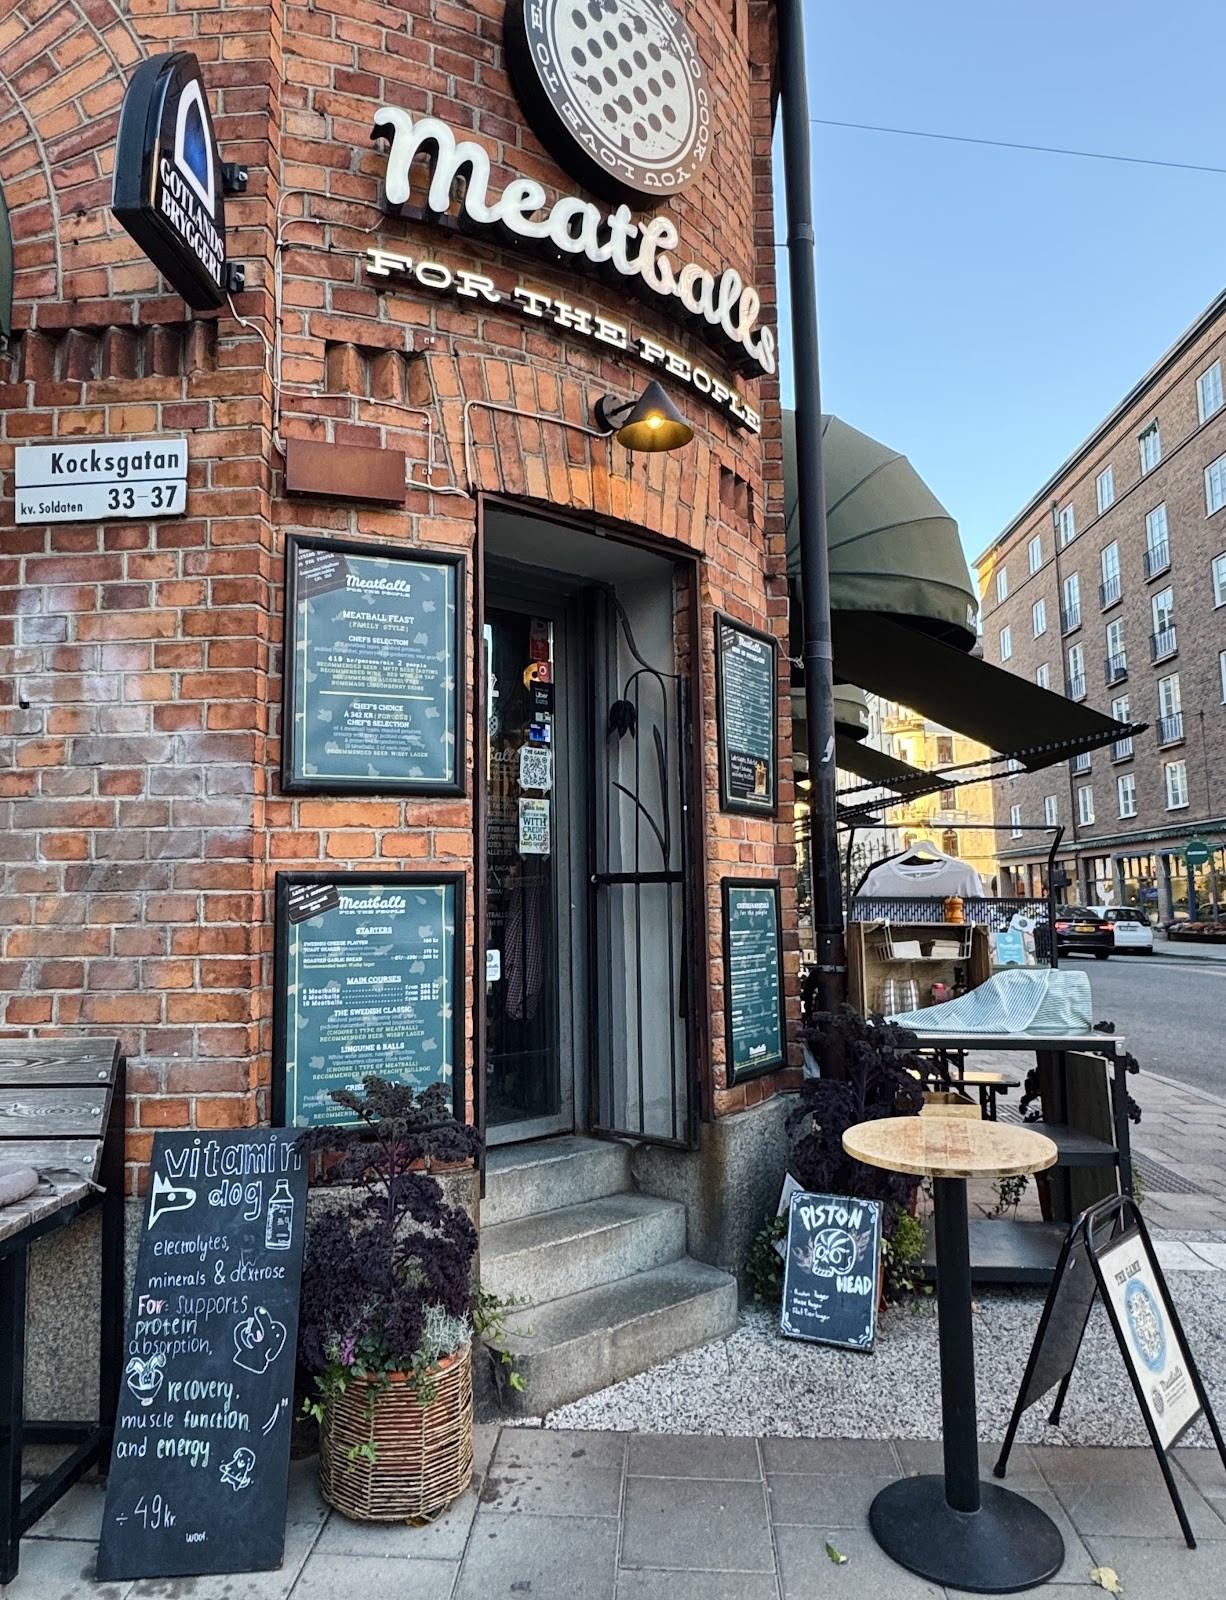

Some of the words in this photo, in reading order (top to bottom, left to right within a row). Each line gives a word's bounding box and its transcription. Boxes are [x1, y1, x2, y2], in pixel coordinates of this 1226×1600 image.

[536, 43, 560, 94] TO
[693, 88, 710, 162] COOK
[562, 102, 635, 180] LOVE
[643, 167, 692, 188] YOU
[160, 158, 224, 262] GOTLANDS
[161, 186, 220, 287] BRYGGERI
[367, 248, 500, 302] FOR
[514, 288, 626, 350] THE
[640, 336, 761, 434] PEOPLE
[52, 449, 178, 478] Kocksgatan
[21, 502, 35, 514] kv.
[39, 500, 83, 513] Soldaten
[346, 574, 411, 592] Meatballs
[342, 611, 386, 622] MEATBALL
[389, 615, 414, 624] FEAST
[373, 637, 409, 646] SELECTION
[523, 817, 546, 826] WITH
[523, 834, 546, 842] CARDS
[339, 896, 406, 909] Meatballs
[356, 927, 392, 935] STARTERS
[347, 977, 367, 985] MAIN
[368, 976, 402, 984] COURSES
[320, 1034, 366, 1042] RECOMMENDED
[341, 1044, 375, 1053] LINGUINE
[382, 1042, 405, 1050] BALLS
[313, 1072, 360, 1080] RECOMMENDED
[165, 1135, 301, 1177] vitamin
[208, 1179, 262, 1222] dog
[800, 1205, 862, 1231] PISTON
[154, 1235, 229, 1261] electrolytes,
[149, 1270, 205, 1288] minerals
[214, 1260, 226, 1285] &
[230, 1260, 285, 1282] dextrose
[1114, 1269, 1127, 1286] THE
[1126, 1260, 1141, 1278] GAME
[836, 1276, 872, 1295] HEAD
[176, 1295, 248, 1321] supports
[135, 1315, 198, 1339] protein
[129, 1333, 212, 1360] absorption,
[122, 1412, 174, 1429] muscle
[117, 1436, 147, 1458] and
